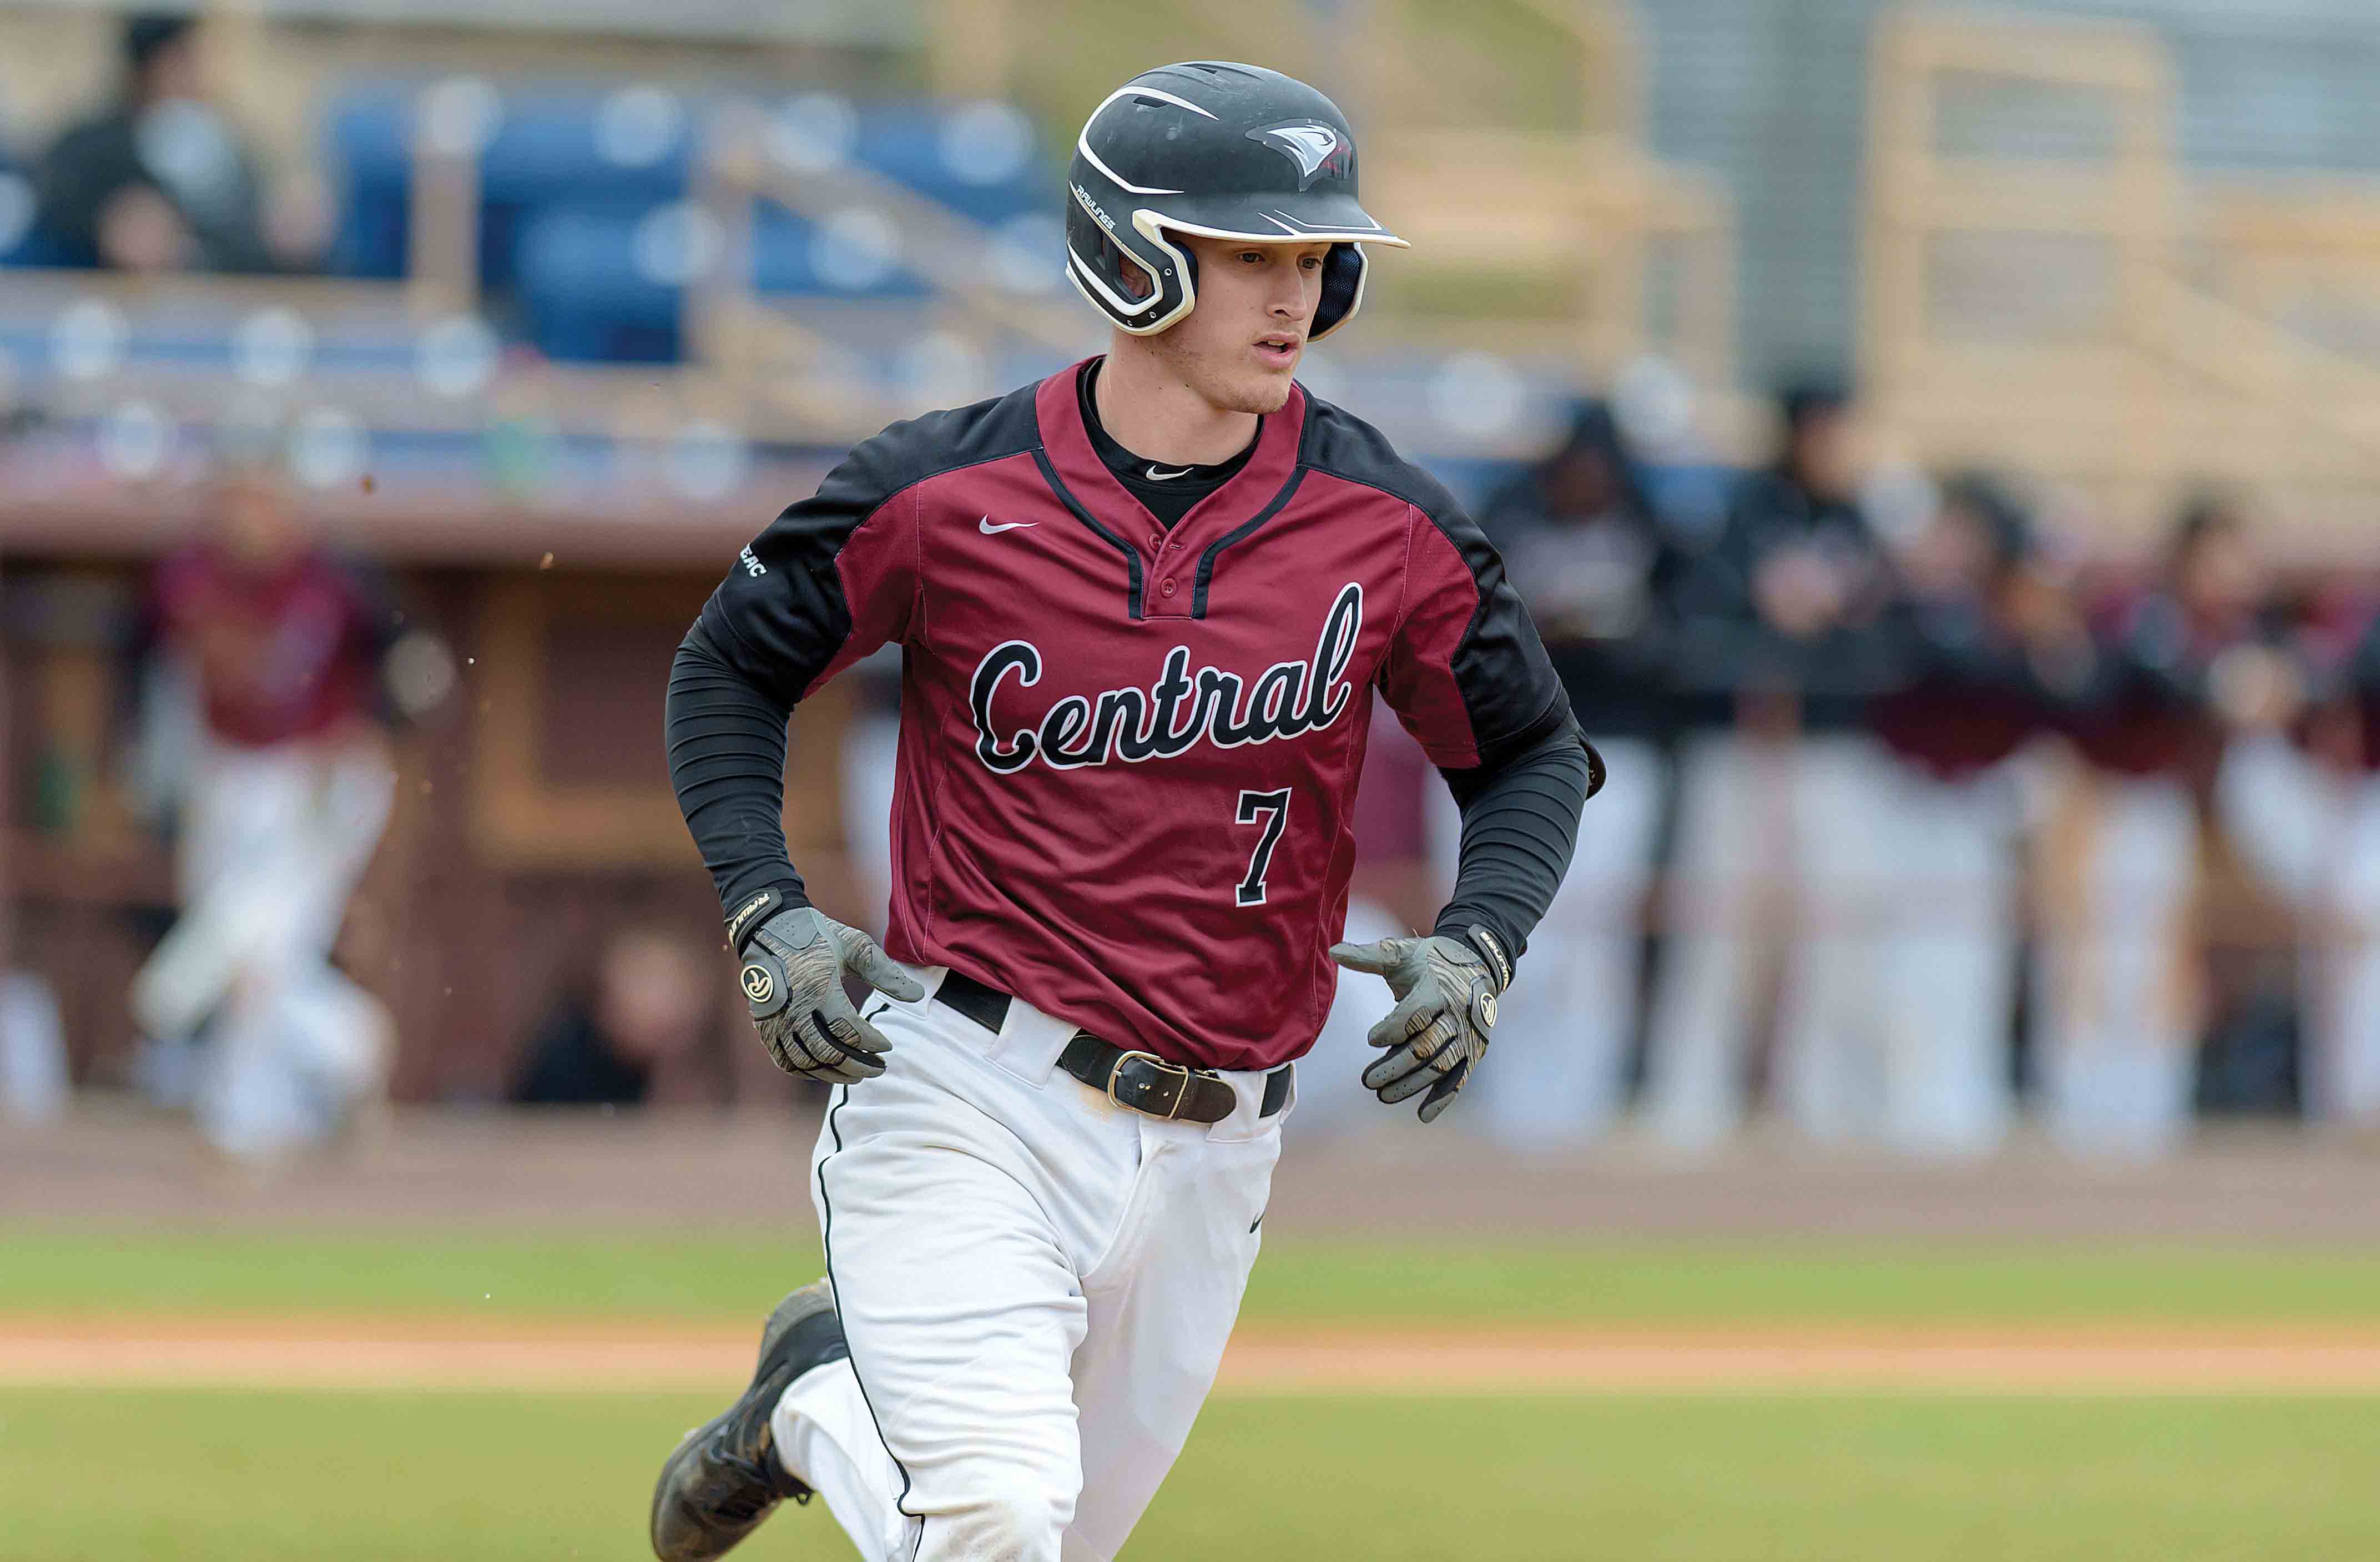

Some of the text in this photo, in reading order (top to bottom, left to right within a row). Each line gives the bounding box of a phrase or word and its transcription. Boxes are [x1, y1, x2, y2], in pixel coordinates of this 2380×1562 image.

[1077, 184, 1116, 231] RAWLINGS
[740, 542, 767, 578] EAC
[970, 582, 1363, 774] Central
[1235, 787, 1292, 907] 7
